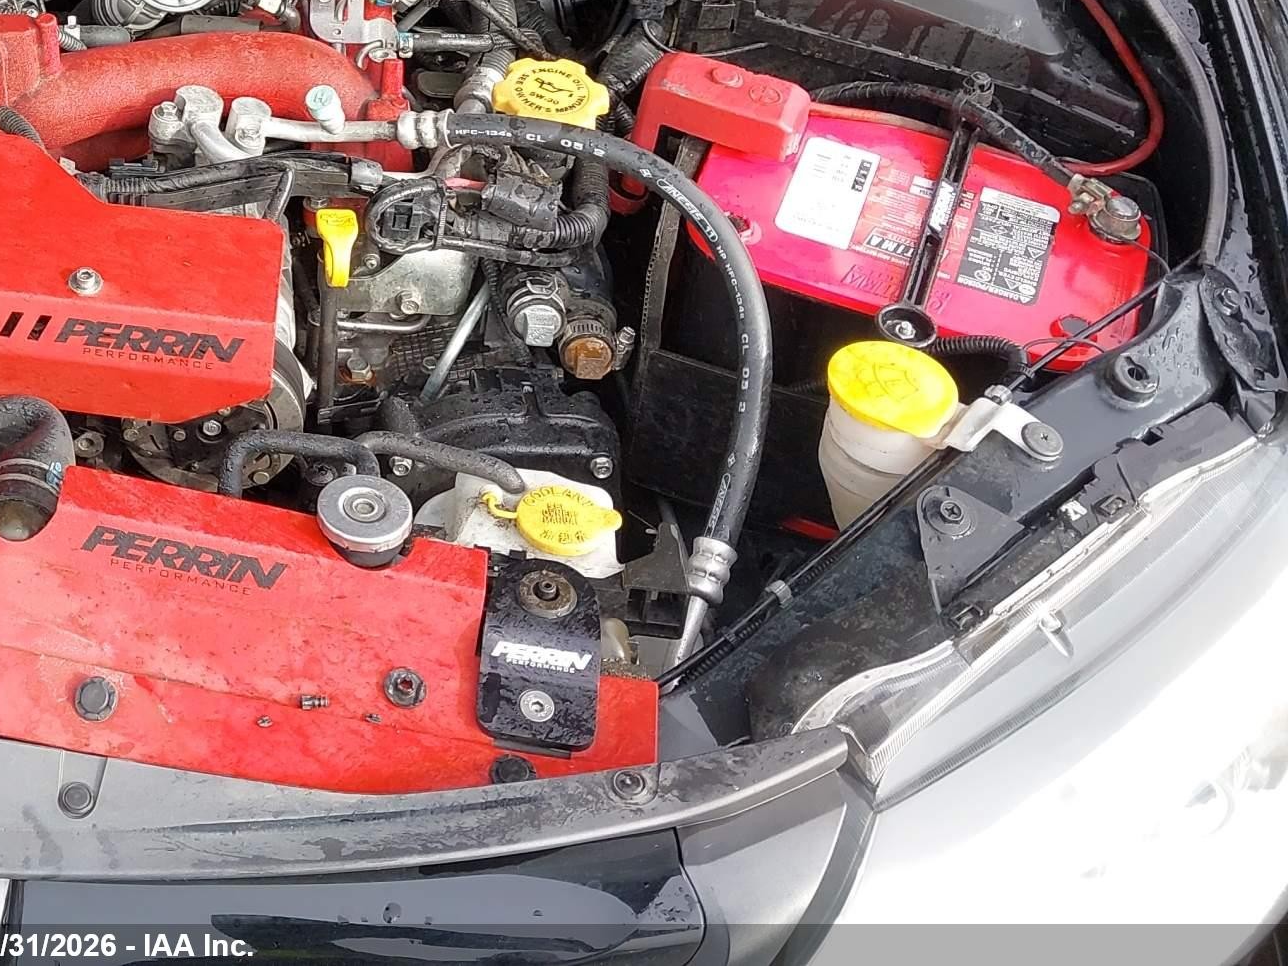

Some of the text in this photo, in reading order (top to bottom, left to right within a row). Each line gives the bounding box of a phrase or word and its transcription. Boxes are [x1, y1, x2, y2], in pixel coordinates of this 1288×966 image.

[532, 68, 585, 90] ENGINE OIL
[516, 74, 530, 85] SEE
[555, 95, 587, 113] MANUAL
[529, 91, 559, 105] 5W-30
[525, 134, 547, 143] CL
[869, 234, 915, 257] TIMA
[716, 245, 727, 260] HP
[741, 333, 750, 355] CL
[54, 317, 245, 363] PERRIN
[82, 347, 215, 370] PERFORMANCE
[79, 525, 289, 590] PERRIN
[109, 558, 252, 596] PERFORMANCE
[490, 640, 593, 670] PERRIN
[505, 657, 576, 674] PERFORMANCE
